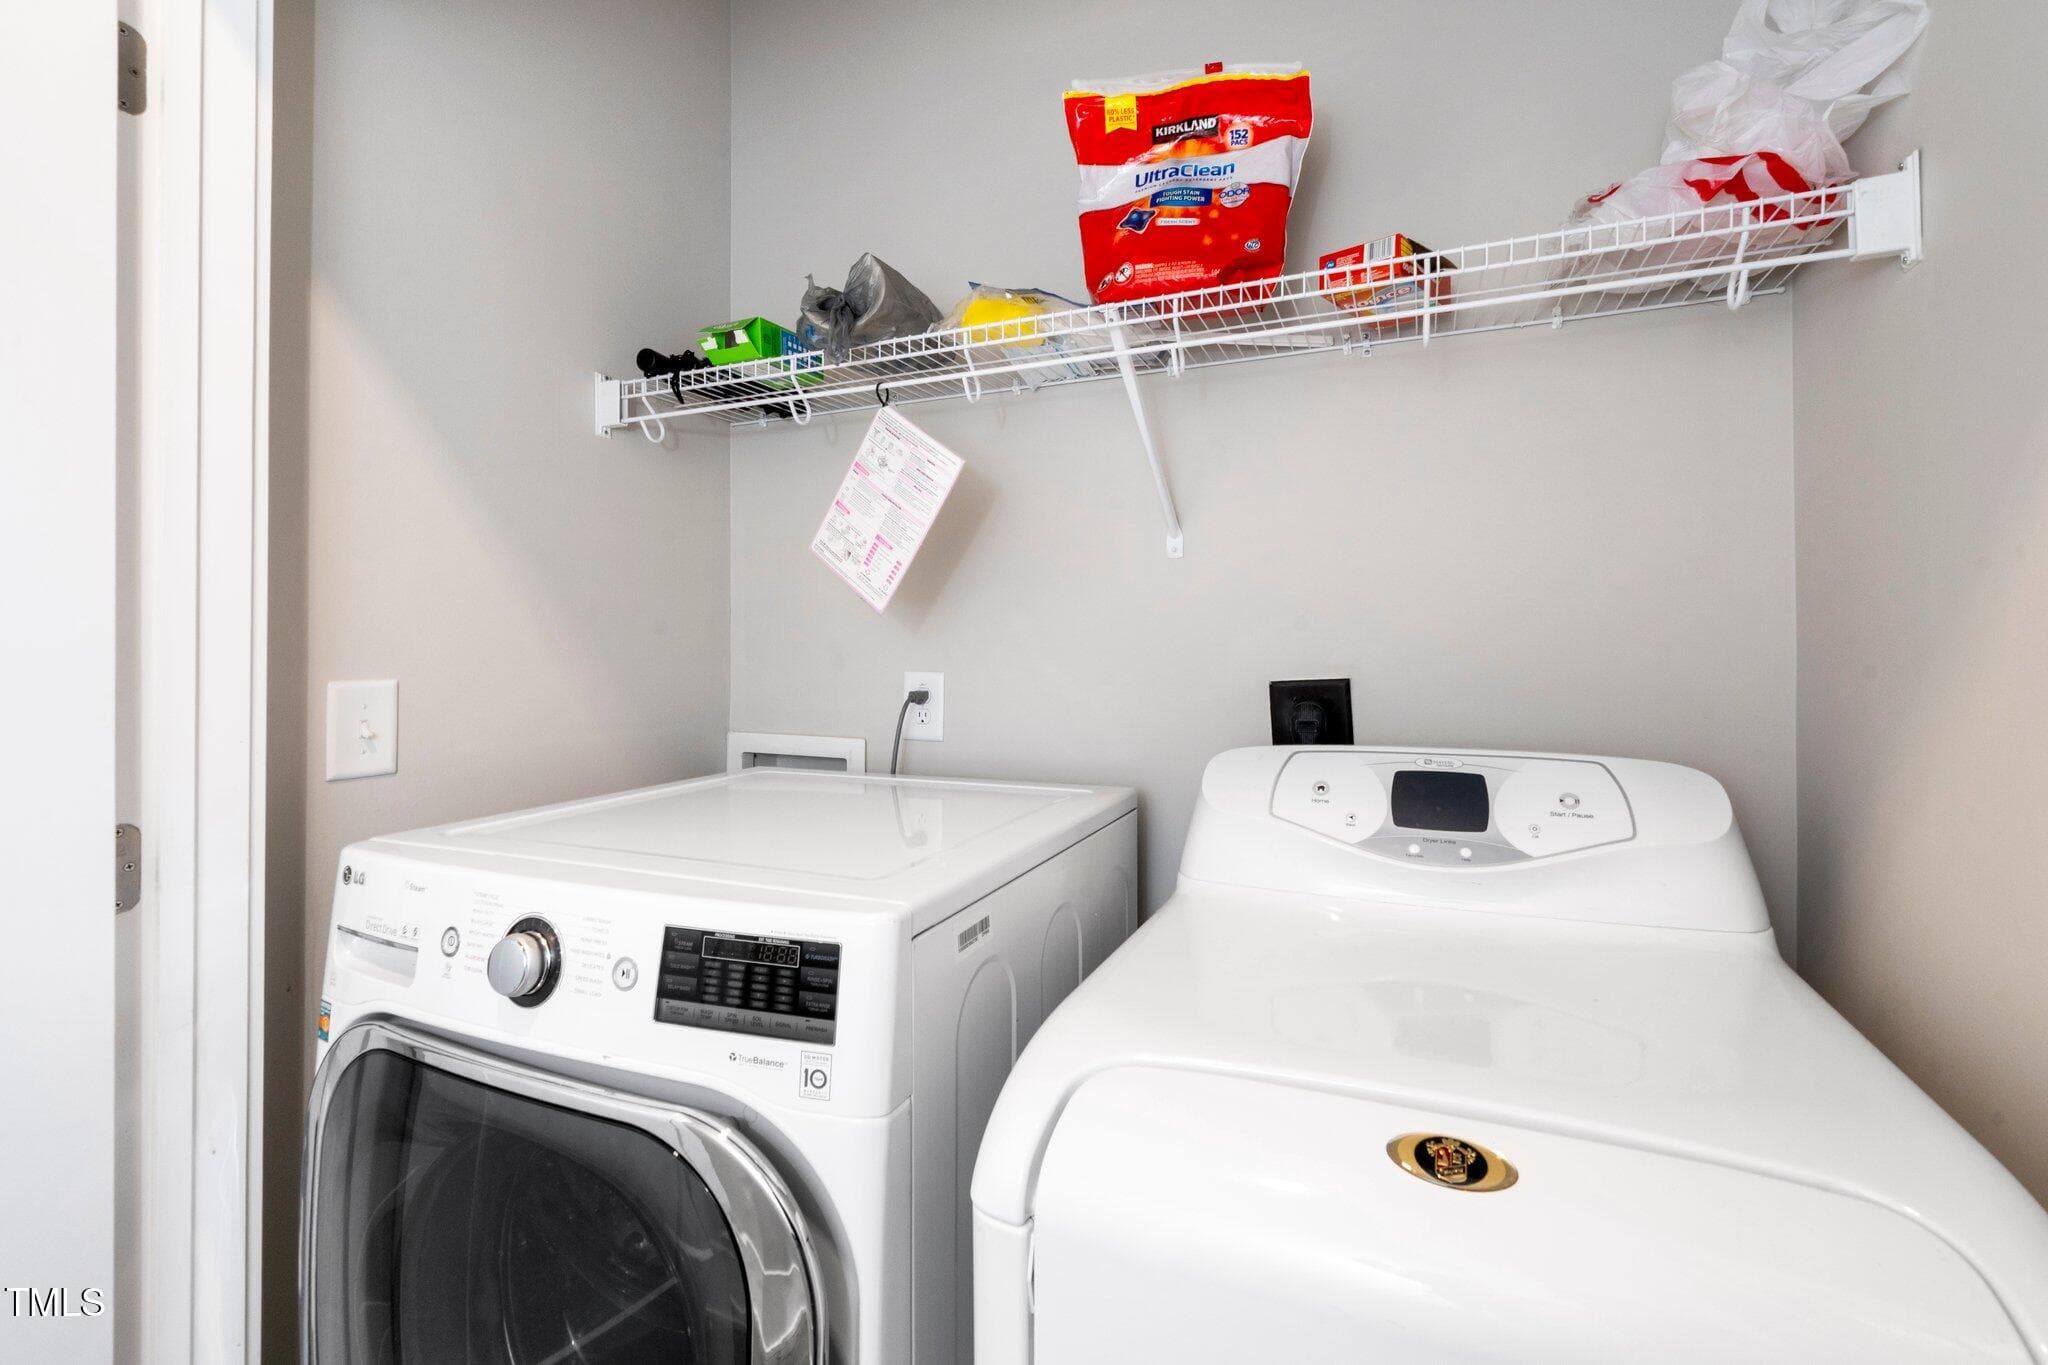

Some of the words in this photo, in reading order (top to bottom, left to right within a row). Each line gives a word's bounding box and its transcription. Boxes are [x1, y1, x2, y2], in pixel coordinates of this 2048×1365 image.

[1120, 107, 1135, 115] LESS
[1155, 117, 1217, 137] KIRKLAND
[1229, 129, 1249, 140] 152
[1135, 163, 1235, 188] UltraClean
[738, 1054, 785, 1068] TrueBalance
[803, 1068, 828, 1090] 10
